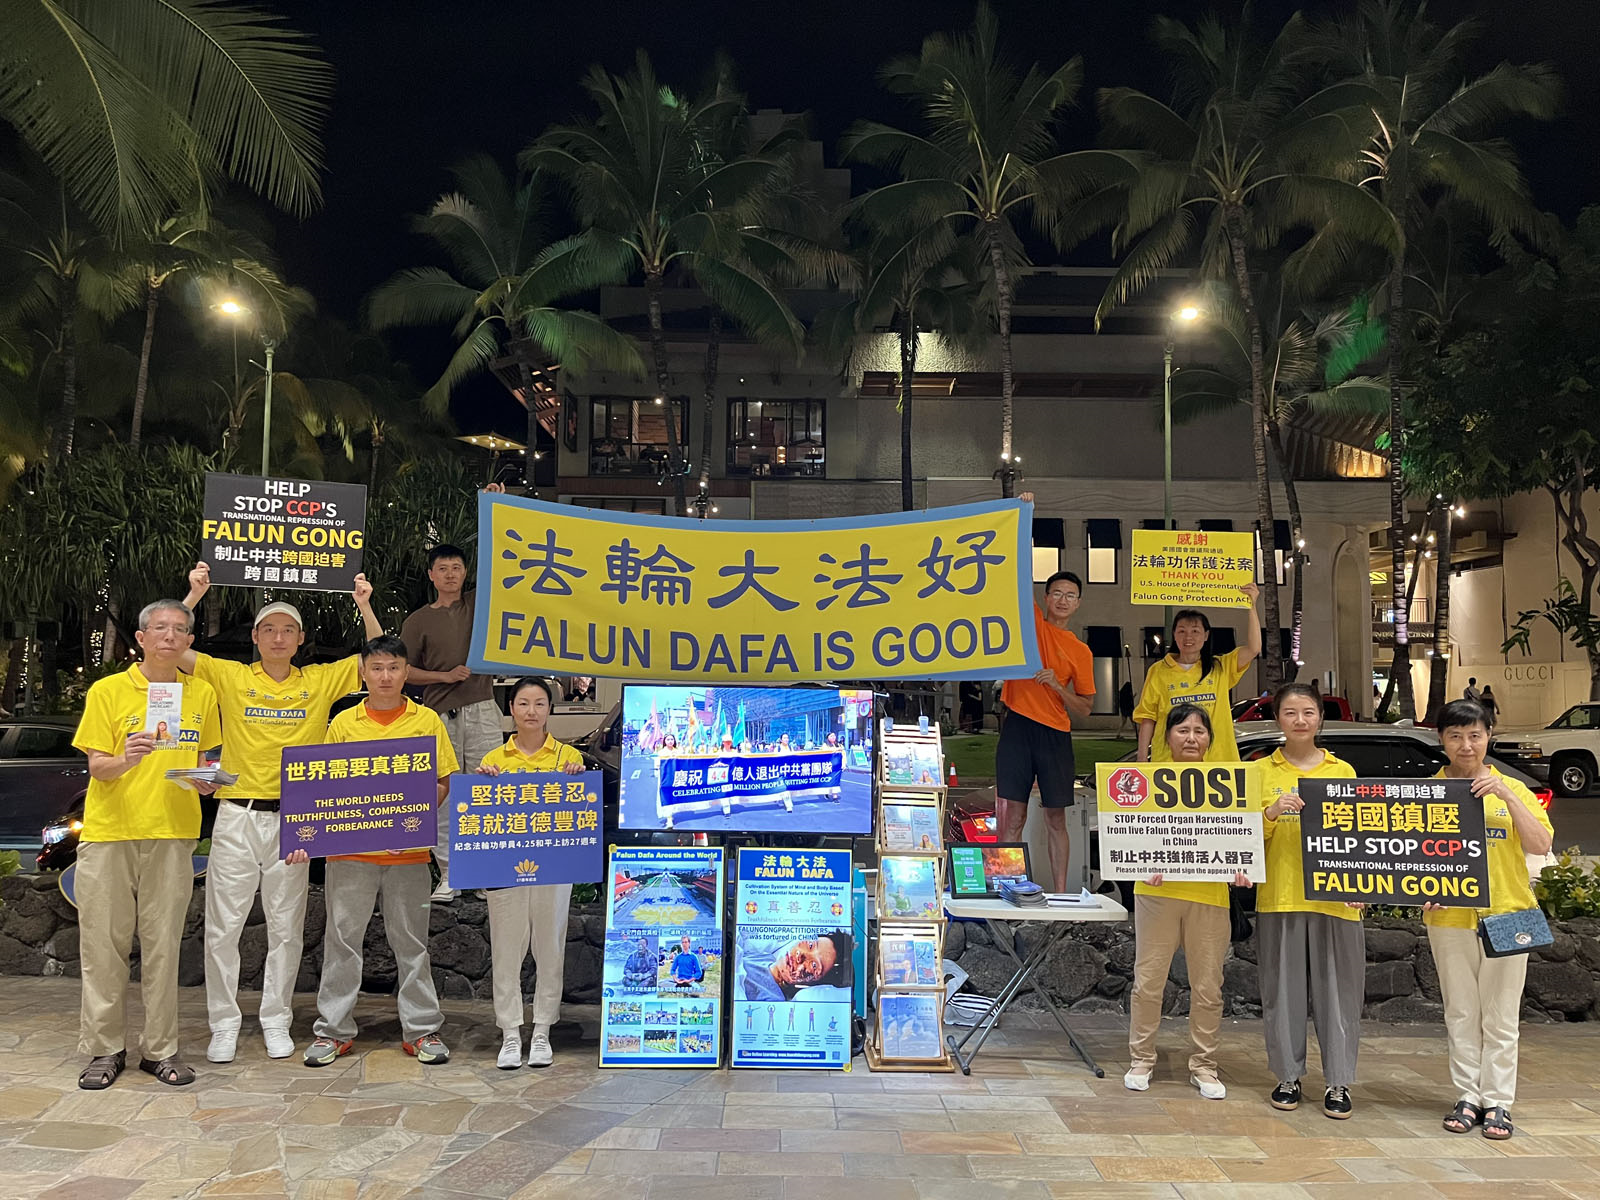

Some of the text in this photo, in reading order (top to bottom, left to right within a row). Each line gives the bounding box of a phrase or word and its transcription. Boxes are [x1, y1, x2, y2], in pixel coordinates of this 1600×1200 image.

[265, 480, 310, 497] HELP
[234, 496, 337, 518] STOP CCP'S
[223, 512, 285, 523] TRANSNATIONAL
[202, 520, 363, 549] FALUN GONG
[1177, 534, 1208, 545] 感謝
[215, 546, 346, 568] 制止中共跨國迫害
[1134, 555, 1252, 571] 法輪功保護法案
[244, 566, 318, 584] 跨國鎮壓
[501, 528, 1006, 612] 法輪大法好
[1161, 571, 1199, 579] THANK
[1160, 594, 1183, 602] Gong
[1186, 595, 1233, 603] Protection
[498, 612, 1012, 674] FALUN DAFA IS GOOD
[1504, 666, 1553, 680] GUCCI
[247, 709, 278, 717] FALUN
[180, 732, 198, 740] AFA
[286, 753, 432, 781] 世界需要真善忍
[672, 770, 703, 787] 慶祝
[712, 770, 726, 781] 4.4
[471, 782, 586, 806] 堅持真善忍
[672, 786, 720, 796] CELEBRATING
[1153, 768, 1247, 808] SOS!
[1327, 784, 1445, 799] 制止中共跨國迫害
[315, 793, 404, 808] THE WORLD NEEDS
[1117, 794, 1142, 804] STOP
[285, 803, 430, 823] TRUTHFULNESS, COMPASSION
[1115, 815, 1243, 825] STOP Forced Organ Harvesting
[1322, 802, 1461, 833] 跨國鎮壓
[326, 820, 393, 832] FORBEARANCE
[458, 810, 598, 836] 鑄就道德豐碑
[1107, 826, 1252, 836] from live Falun Gong practitioners
[1163, 837, 1197, 846] in China
[1307, 836, 1481, 857] HELP STOP CCP'S
[763, 855, 826, 867] 法輪大法
[1110, 850, 1253, 864] 制止中共強摘活人器官
[755, 868, 834, 878] FALUN DAFA
[1318, 860, 1393, 870] TRANSNATIONAL
[1395, 862, 1453, 872] REPRESSION
[1313, 872, 1480, 898] FALUN GONG
[768, 900, 822, 914] 真善忍
